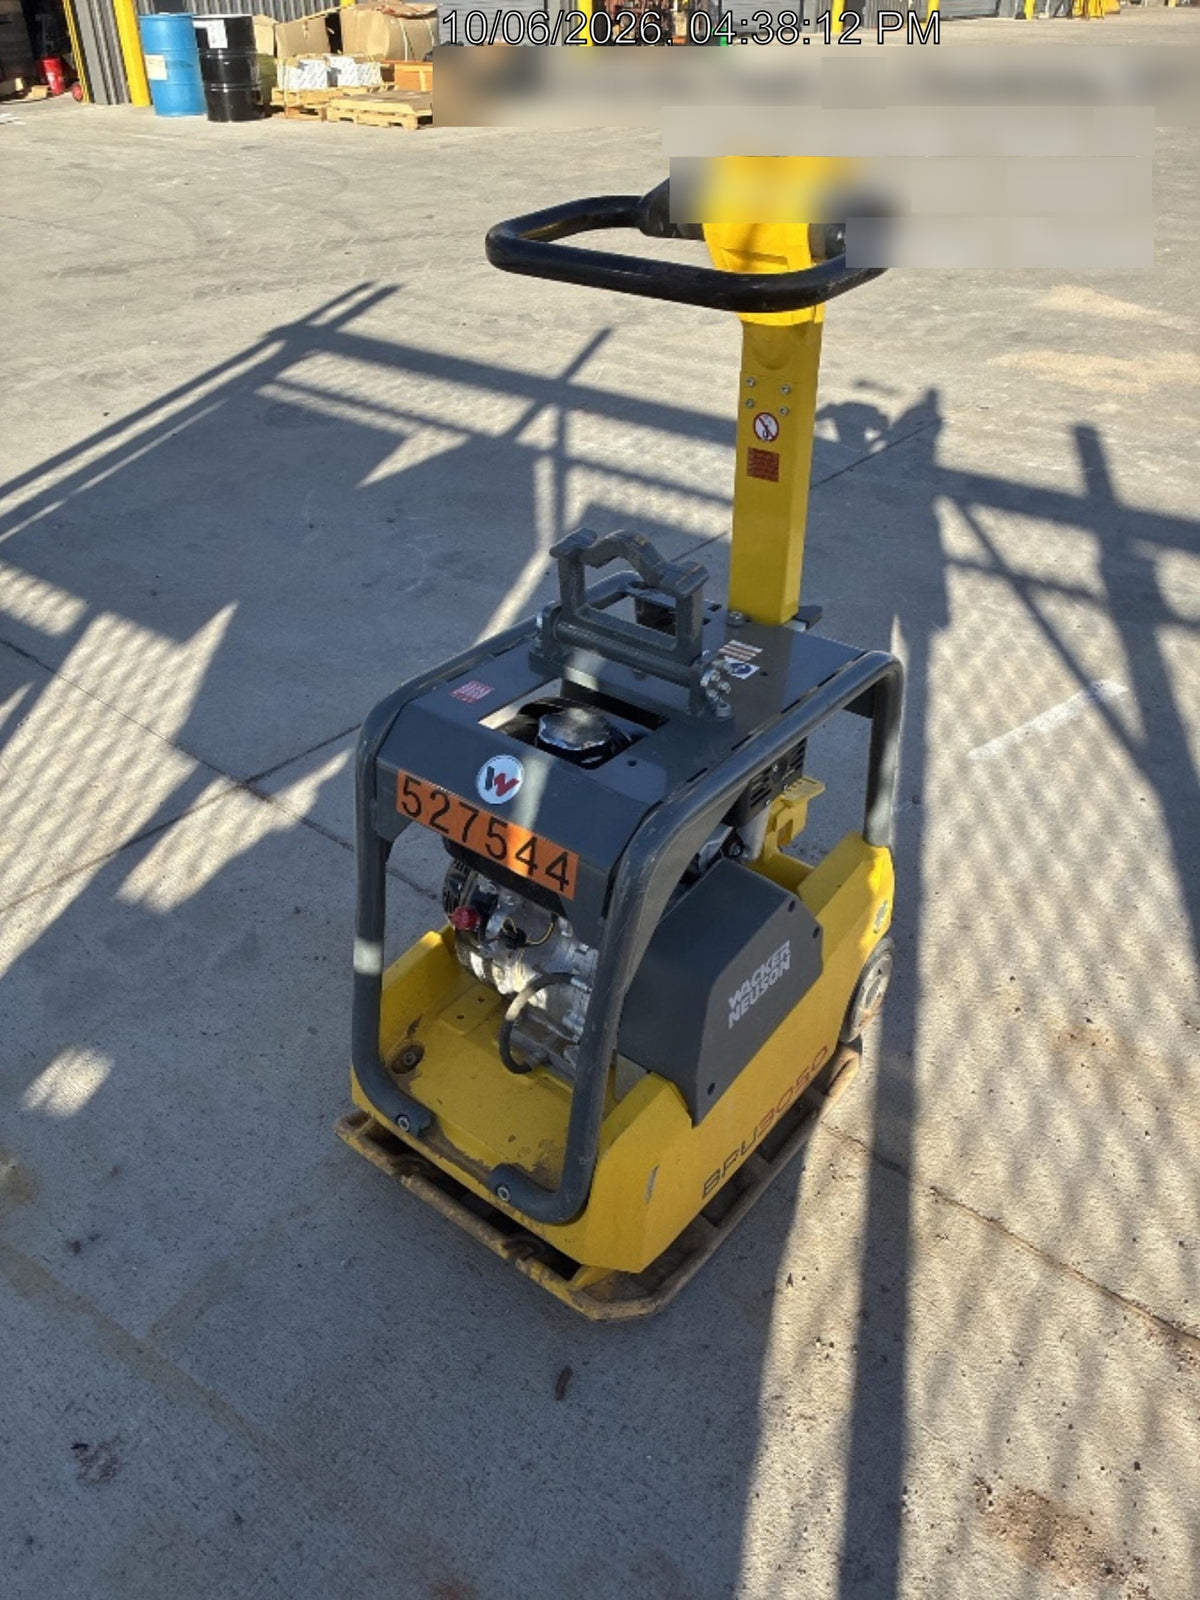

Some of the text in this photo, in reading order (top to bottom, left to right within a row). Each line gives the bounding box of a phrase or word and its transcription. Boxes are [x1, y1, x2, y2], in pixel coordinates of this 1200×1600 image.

[402, 775, 570, 892] 527544
[728, 940, 790, 1009] WACKER
[728, 954, 790, 1030] NEUSON
